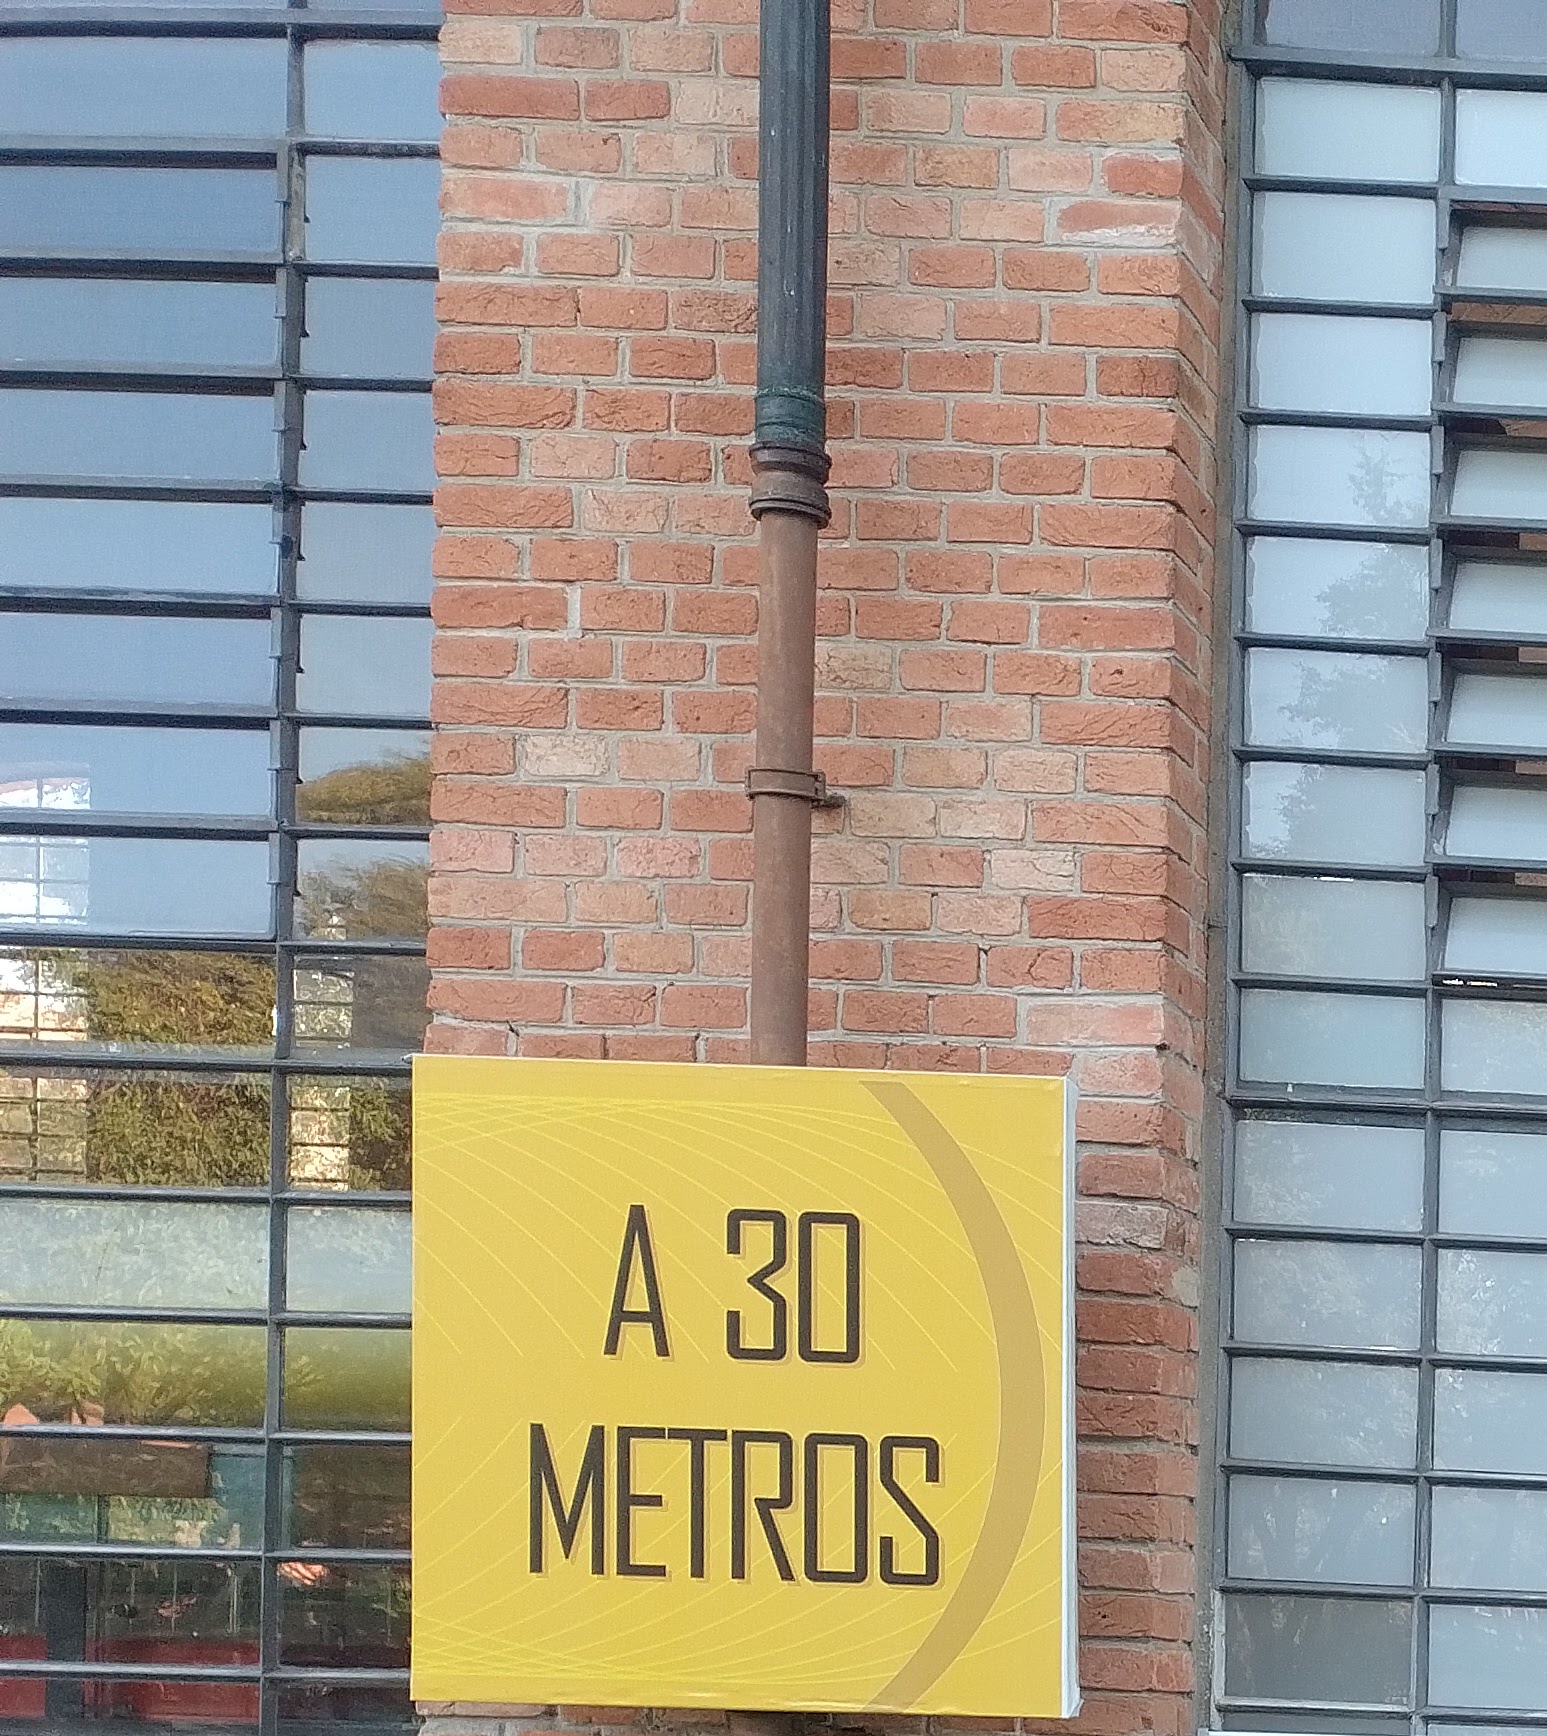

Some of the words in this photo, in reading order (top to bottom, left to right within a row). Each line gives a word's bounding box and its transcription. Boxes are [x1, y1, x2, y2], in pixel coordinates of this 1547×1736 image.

[603, 1203, 670, 1357] A
[725, 1207, 861, 1364] 30
[528, 1422, 942, 1586] METROS
